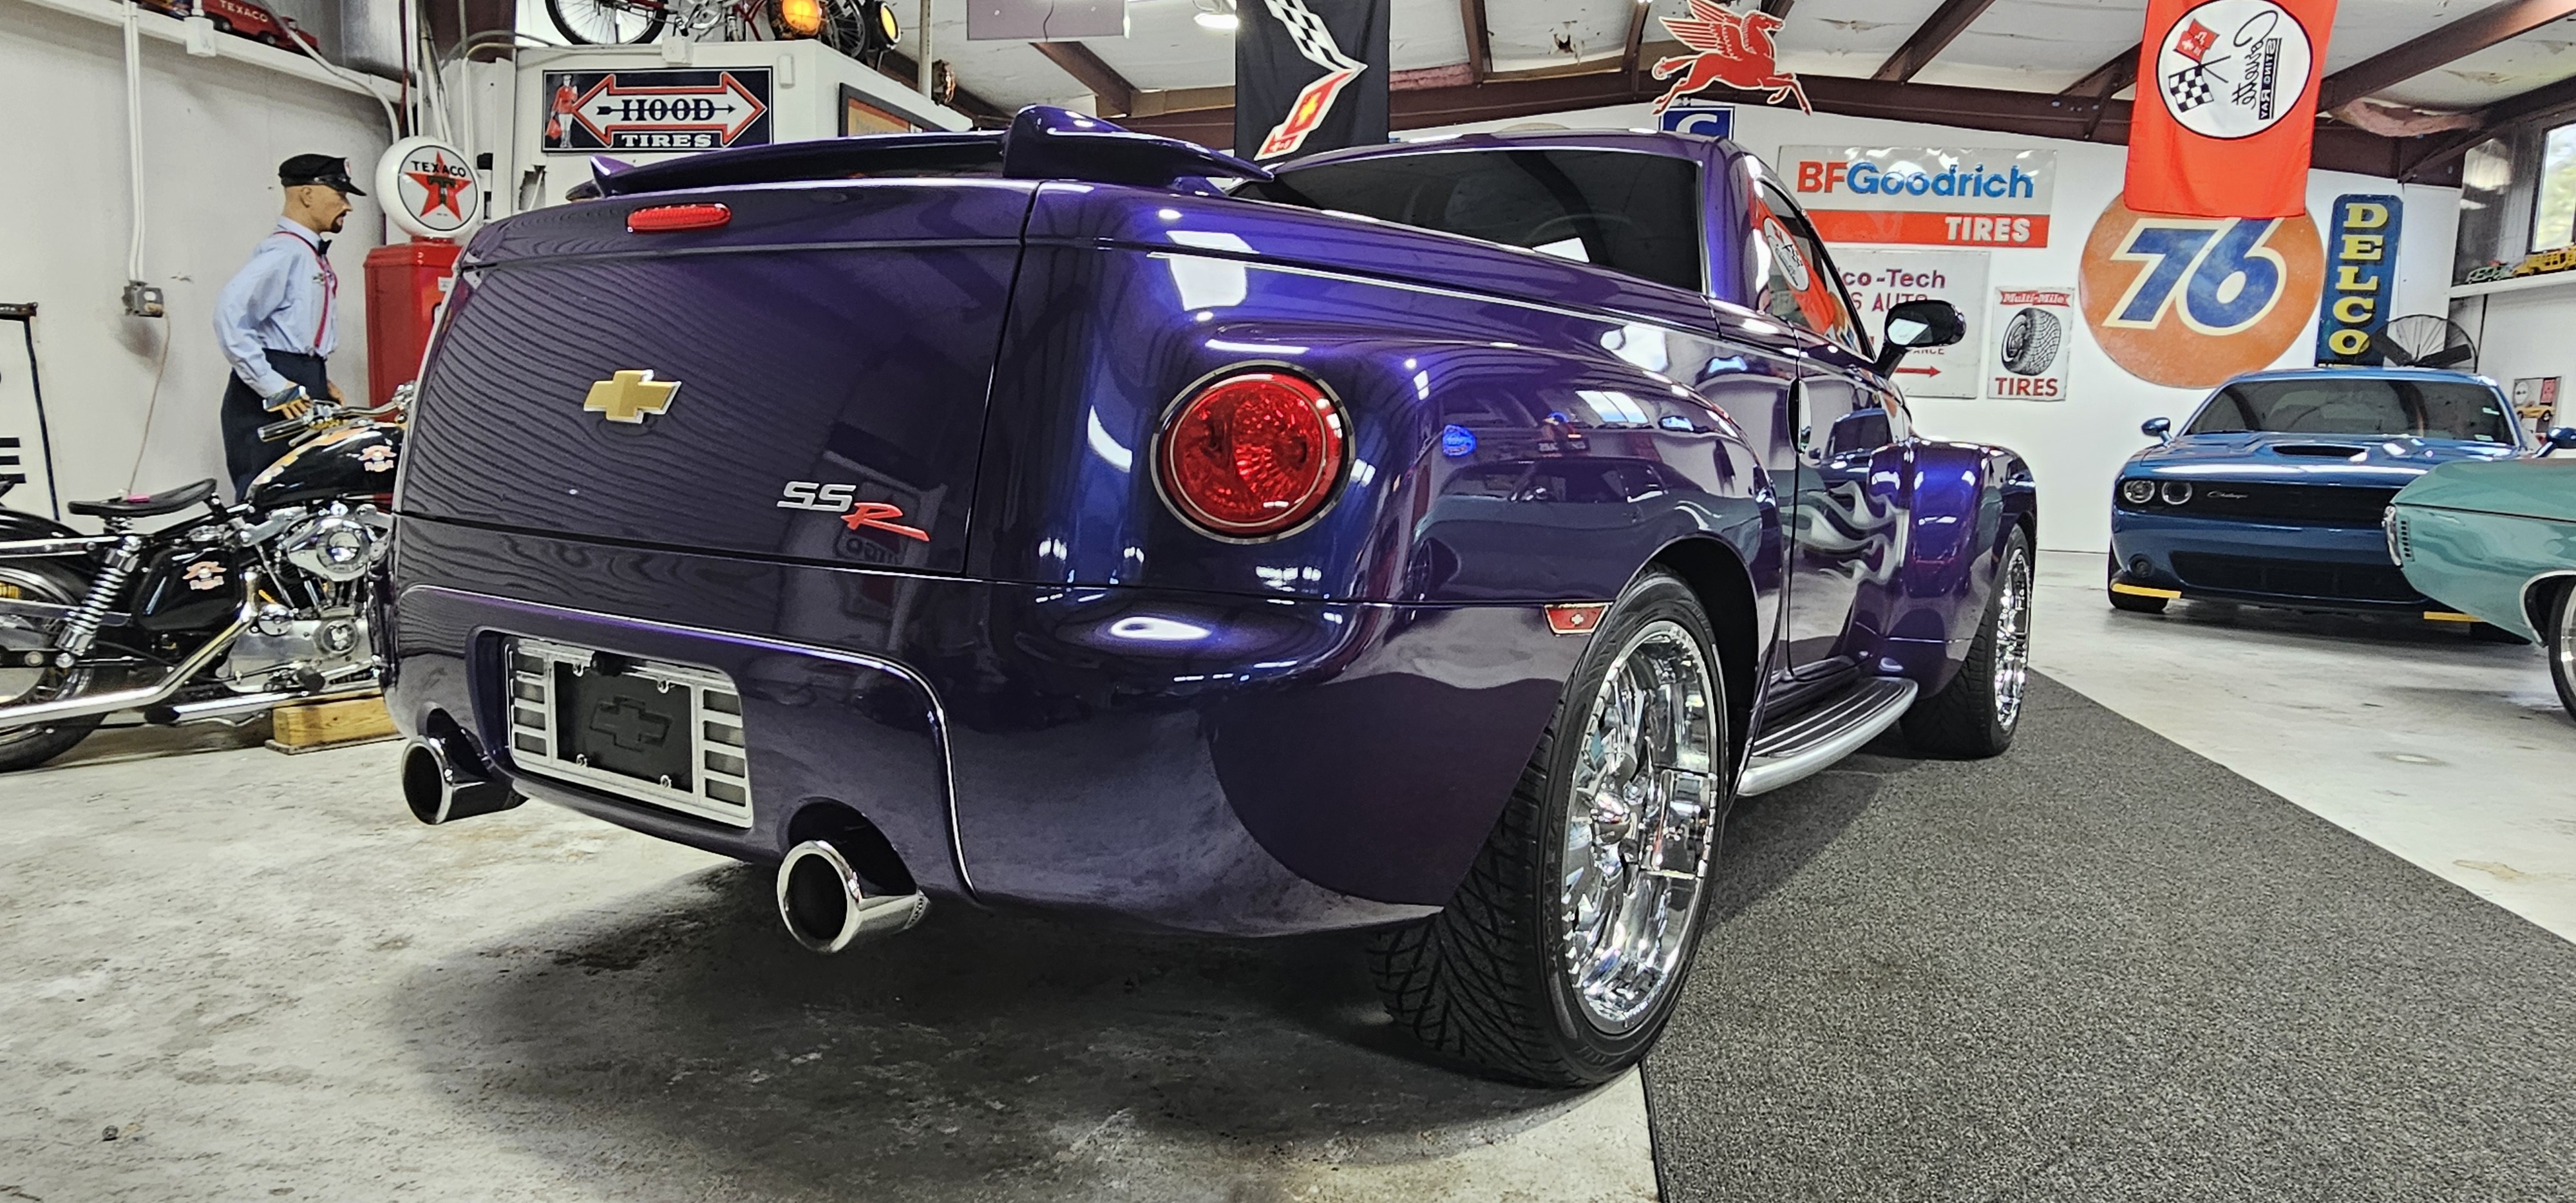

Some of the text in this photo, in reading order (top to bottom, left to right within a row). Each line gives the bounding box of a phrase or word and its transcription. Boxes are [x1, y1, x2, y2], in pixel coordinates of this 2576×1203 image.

[219, 0, 268, 23] TEXACO
[621, 99, 715, 121] HOOD
[622, 135, 712, 147] TIRES
[411, 160, 467, 178] TEXACO
[1797, 161, 2034, 198] BFGoodrich
[1946, 217, 2031, 242] TIRES
[1838, 267, 1946, 288] co-Tech
[2103, 218, 2286, 336] 76
[2329, 202, 2389, 355] DELCO
[2003, 293, 2065, 305] Multi-Mile
[1995, 377, 2058, 397] TIRES
